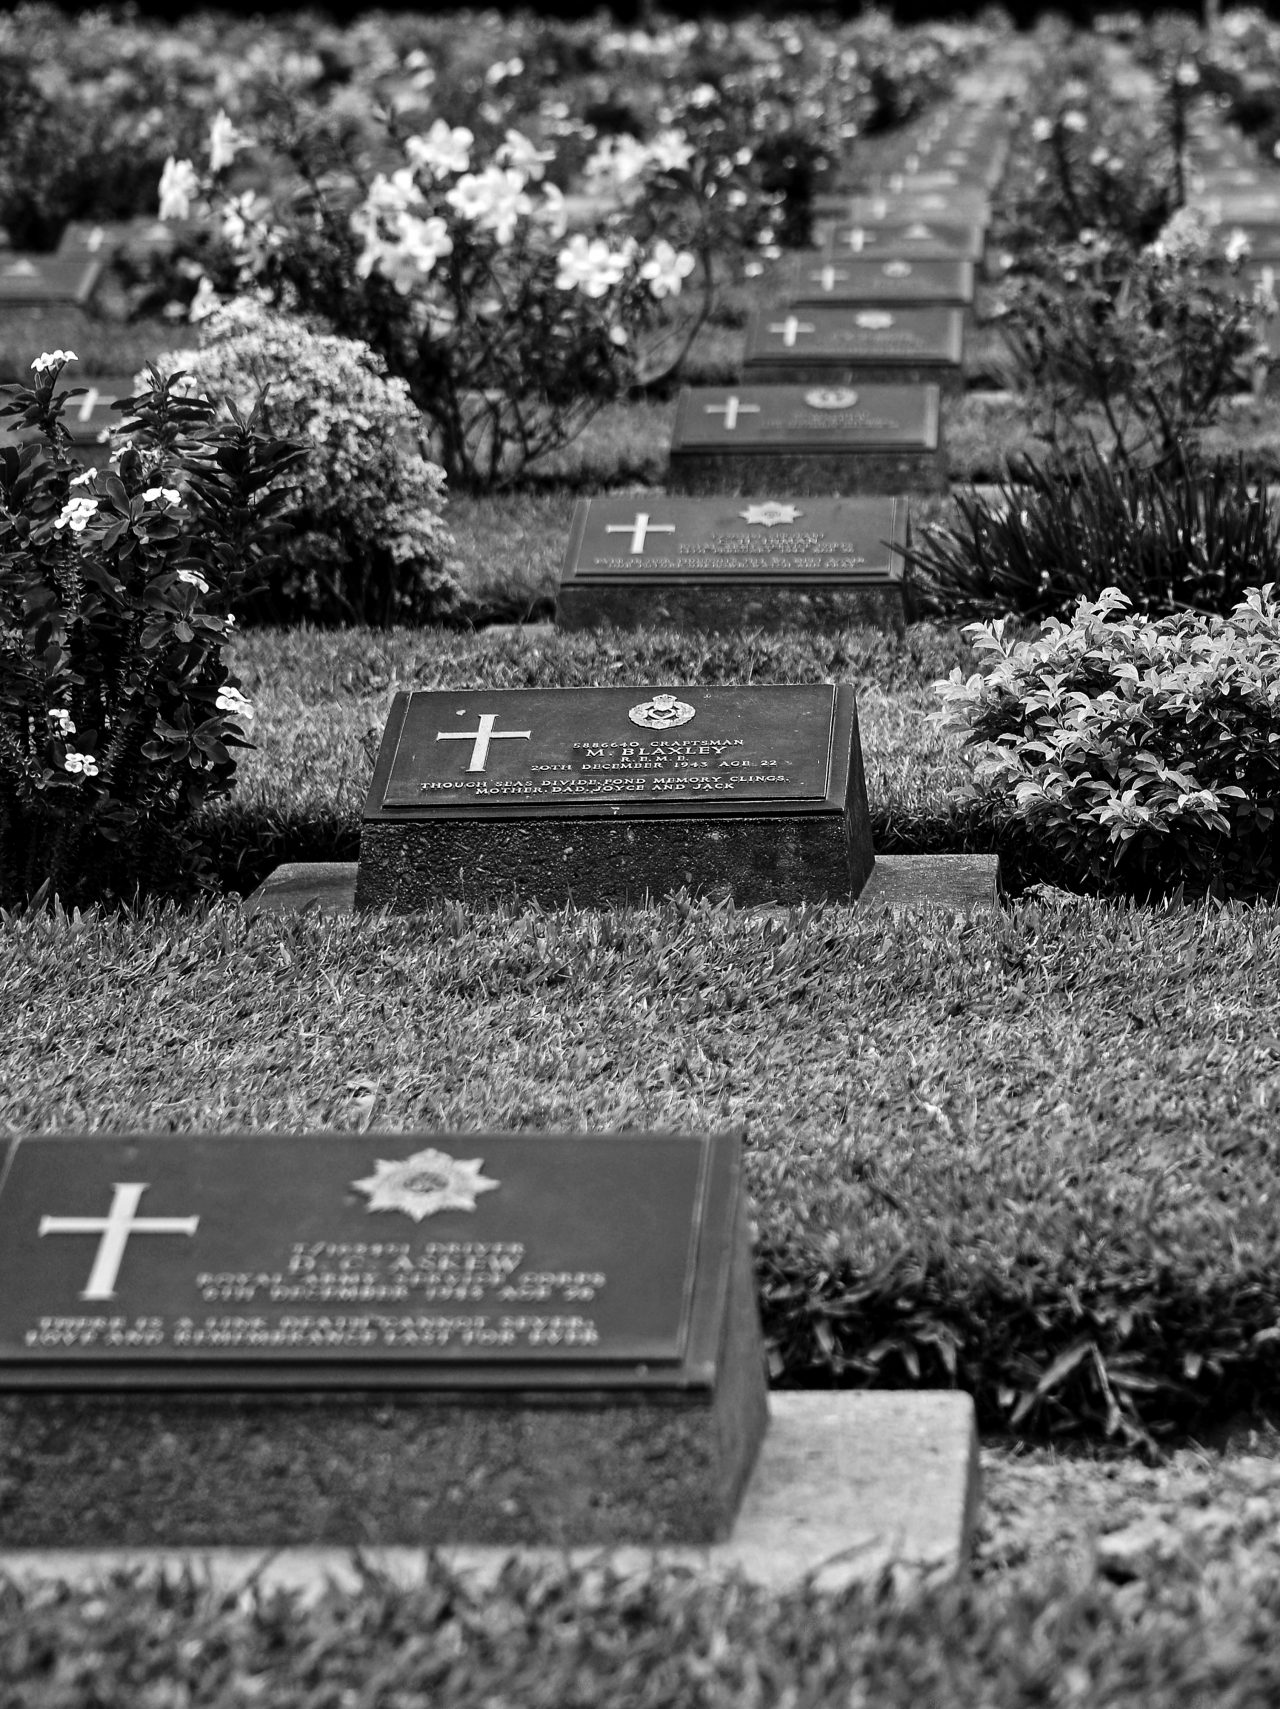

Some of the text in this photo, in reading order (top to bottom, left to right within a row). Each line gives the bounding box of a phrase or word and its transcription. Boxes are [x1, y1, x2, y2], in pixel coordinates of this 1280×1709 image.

[650, 739, 744, 747] CRAFTSMAN
[622, 746, 728, 756] BLAXLEY
[582, 762, 663, 770] DECEMBER
[421, 781, 487, 789] THOUGH
[653, 776, 721, 784] MEMORY
[389, 1254, 524, 1274] ASKEW
